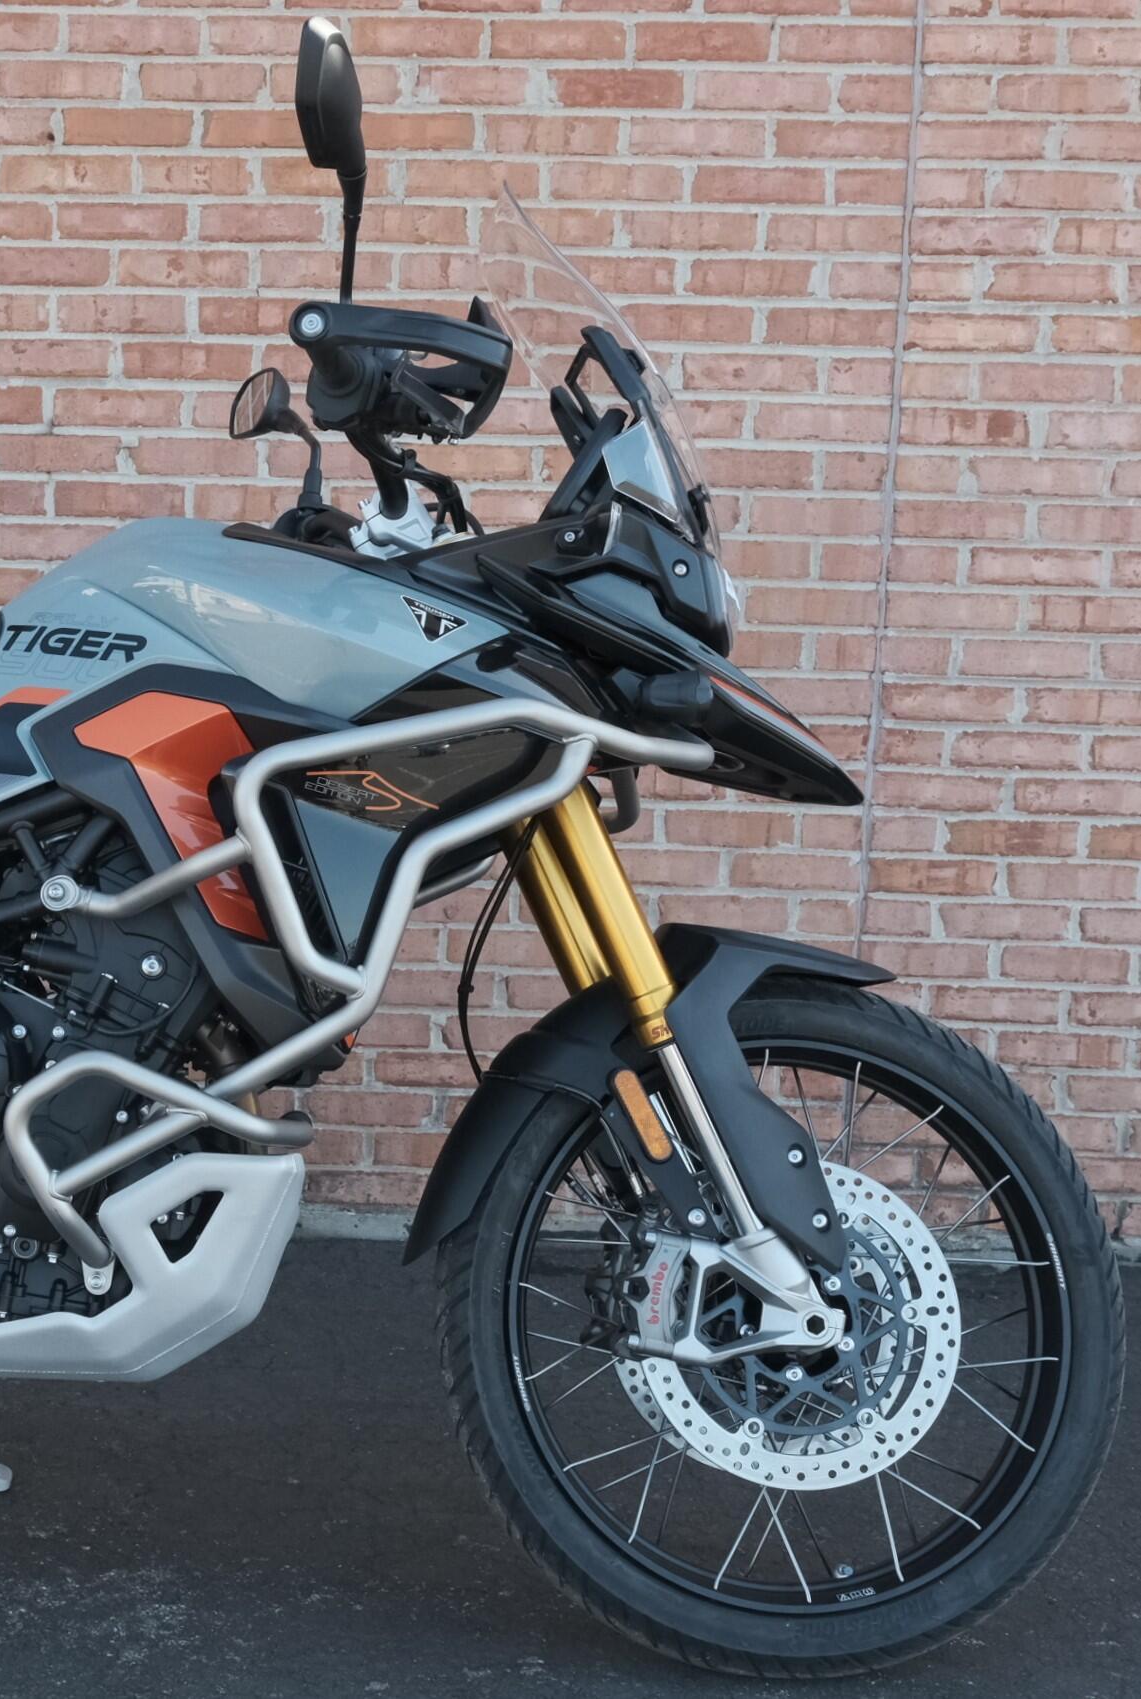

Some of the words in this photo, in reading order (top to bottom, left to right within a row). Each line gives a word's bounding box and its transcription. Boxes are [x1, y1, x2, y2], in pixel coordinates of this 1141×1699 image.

[2, 624, 148, 663] TIGER
[304, 781, 361, 805] EDITION
[317, 777, 380, 801] DESERT
[646, 1262, 668, 1324] brembo
